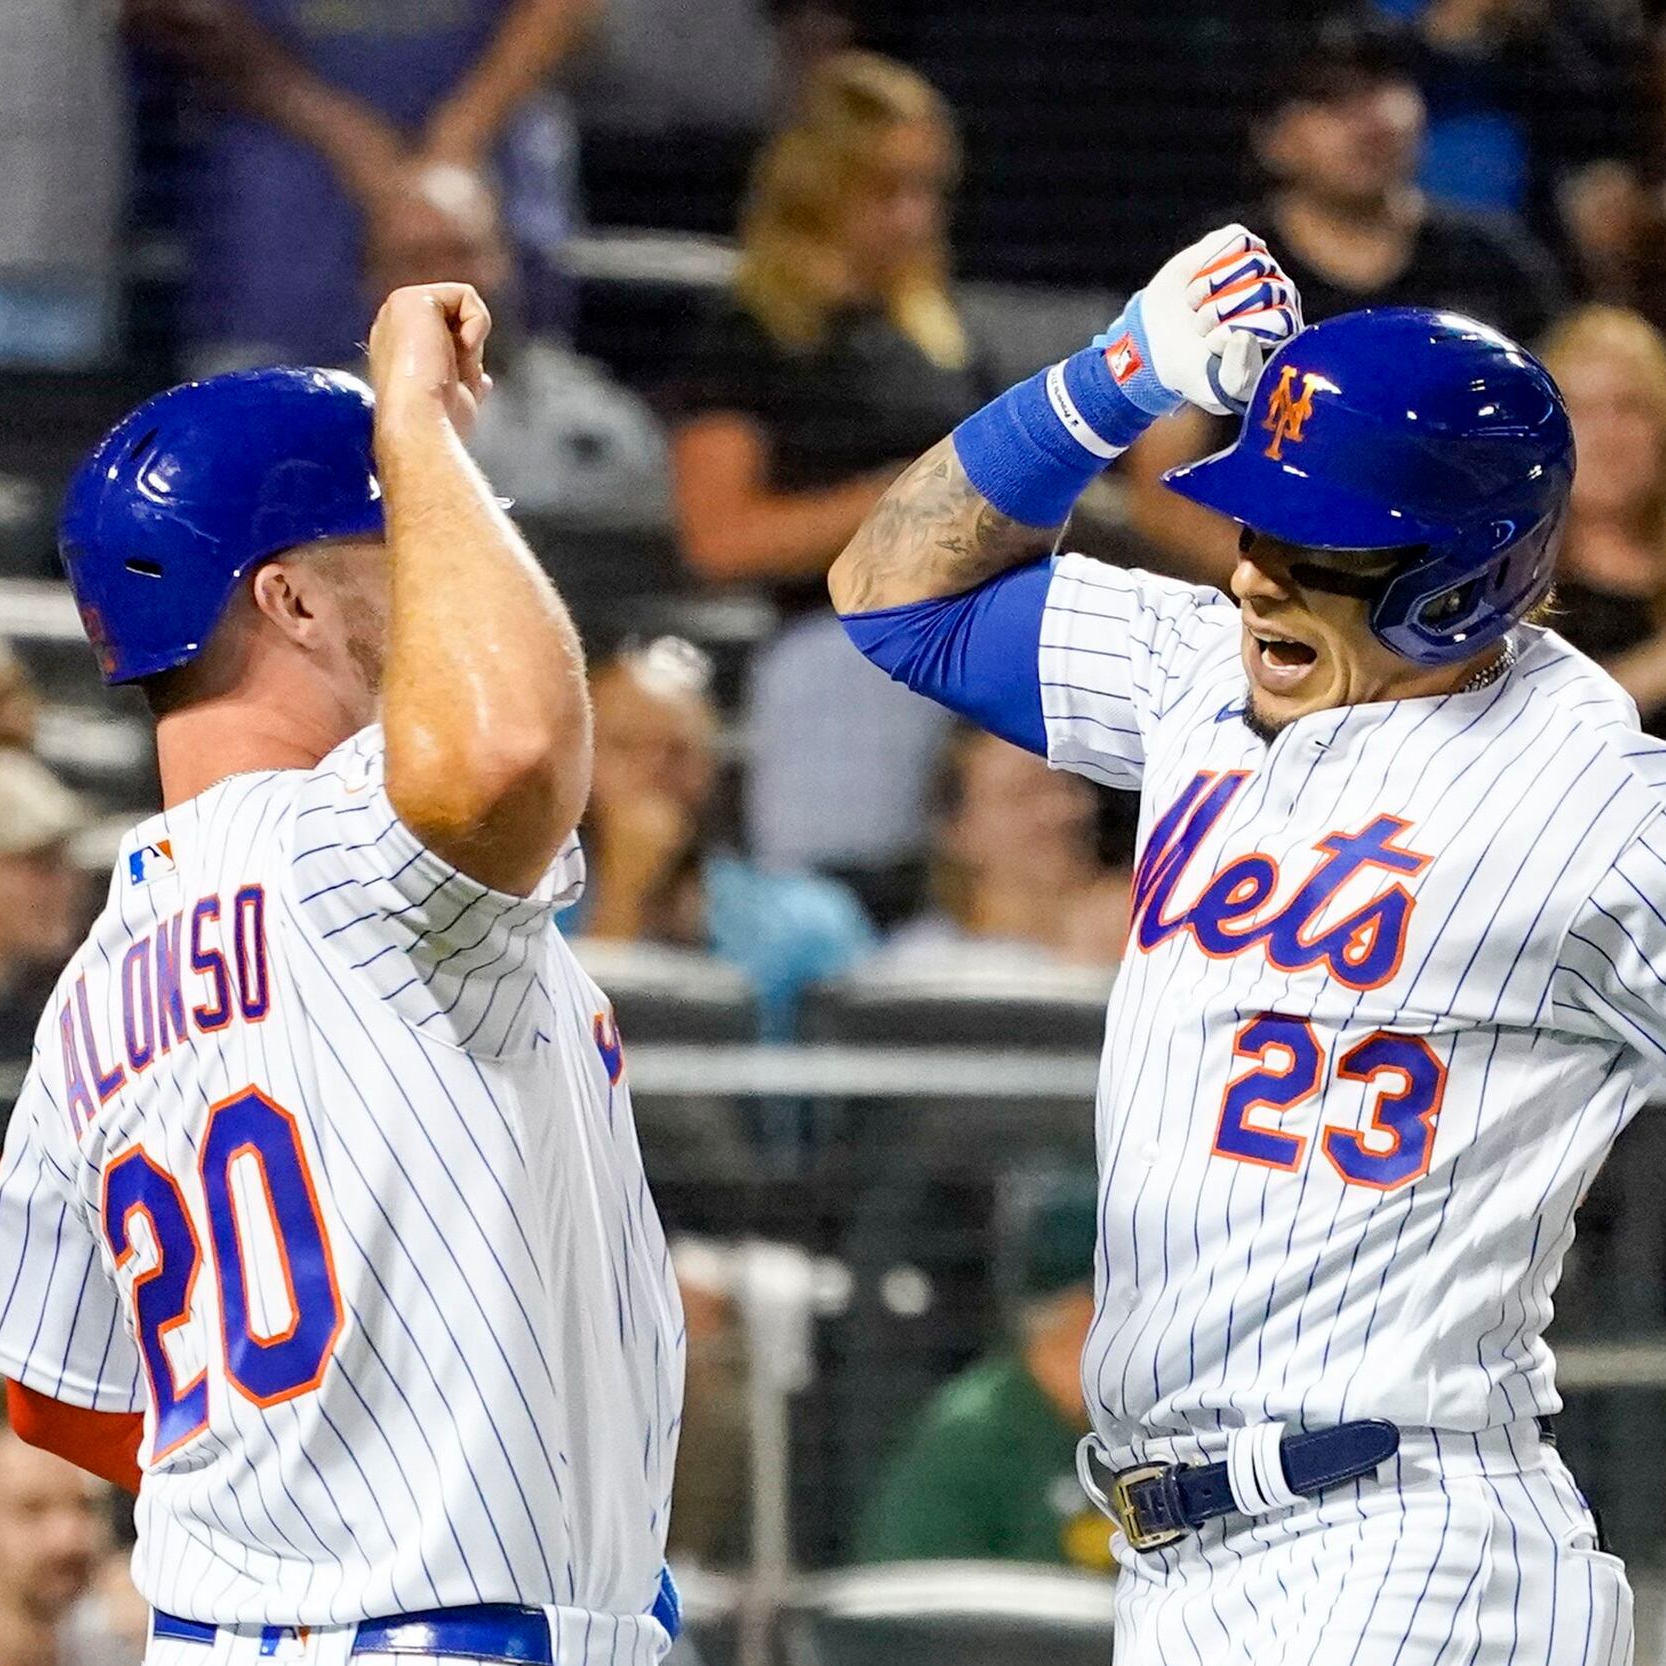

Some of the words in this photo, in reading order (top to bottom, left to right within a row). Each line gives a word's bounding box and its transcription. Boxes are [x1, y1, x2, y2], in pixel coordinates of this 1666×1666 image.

[1129, 769, 1435, 991] Mets
[60, 883, 271, 1143] ALONSO
[1210, 1010, 1448, 1191] 23
[101, 1083, 346, 1466] 20
